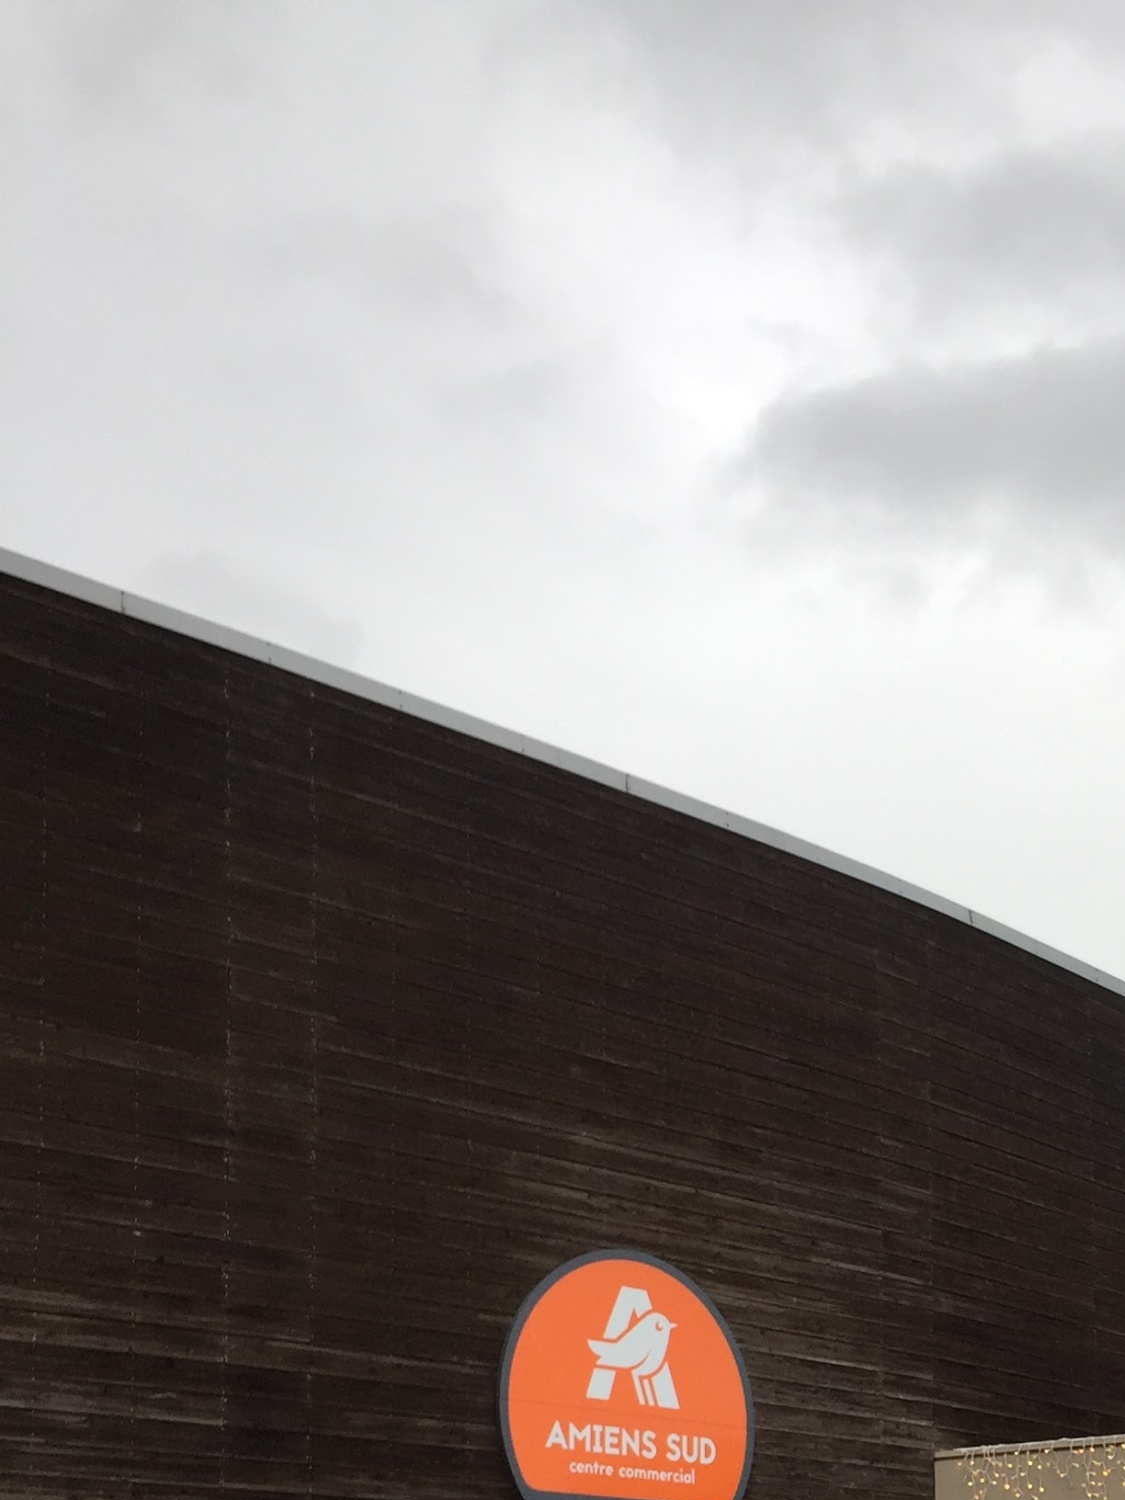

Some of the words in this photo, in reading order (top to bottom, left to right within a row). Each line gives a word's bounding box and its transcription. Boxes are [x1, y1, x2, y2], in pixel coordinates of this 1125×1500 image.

[546, 1420, 657, 1460] AMIENS
[666, 1432, 717, 1465] SUD
[569, 1460, 614, 1477] centre
[619, 1466, 696, 1485] commercial
